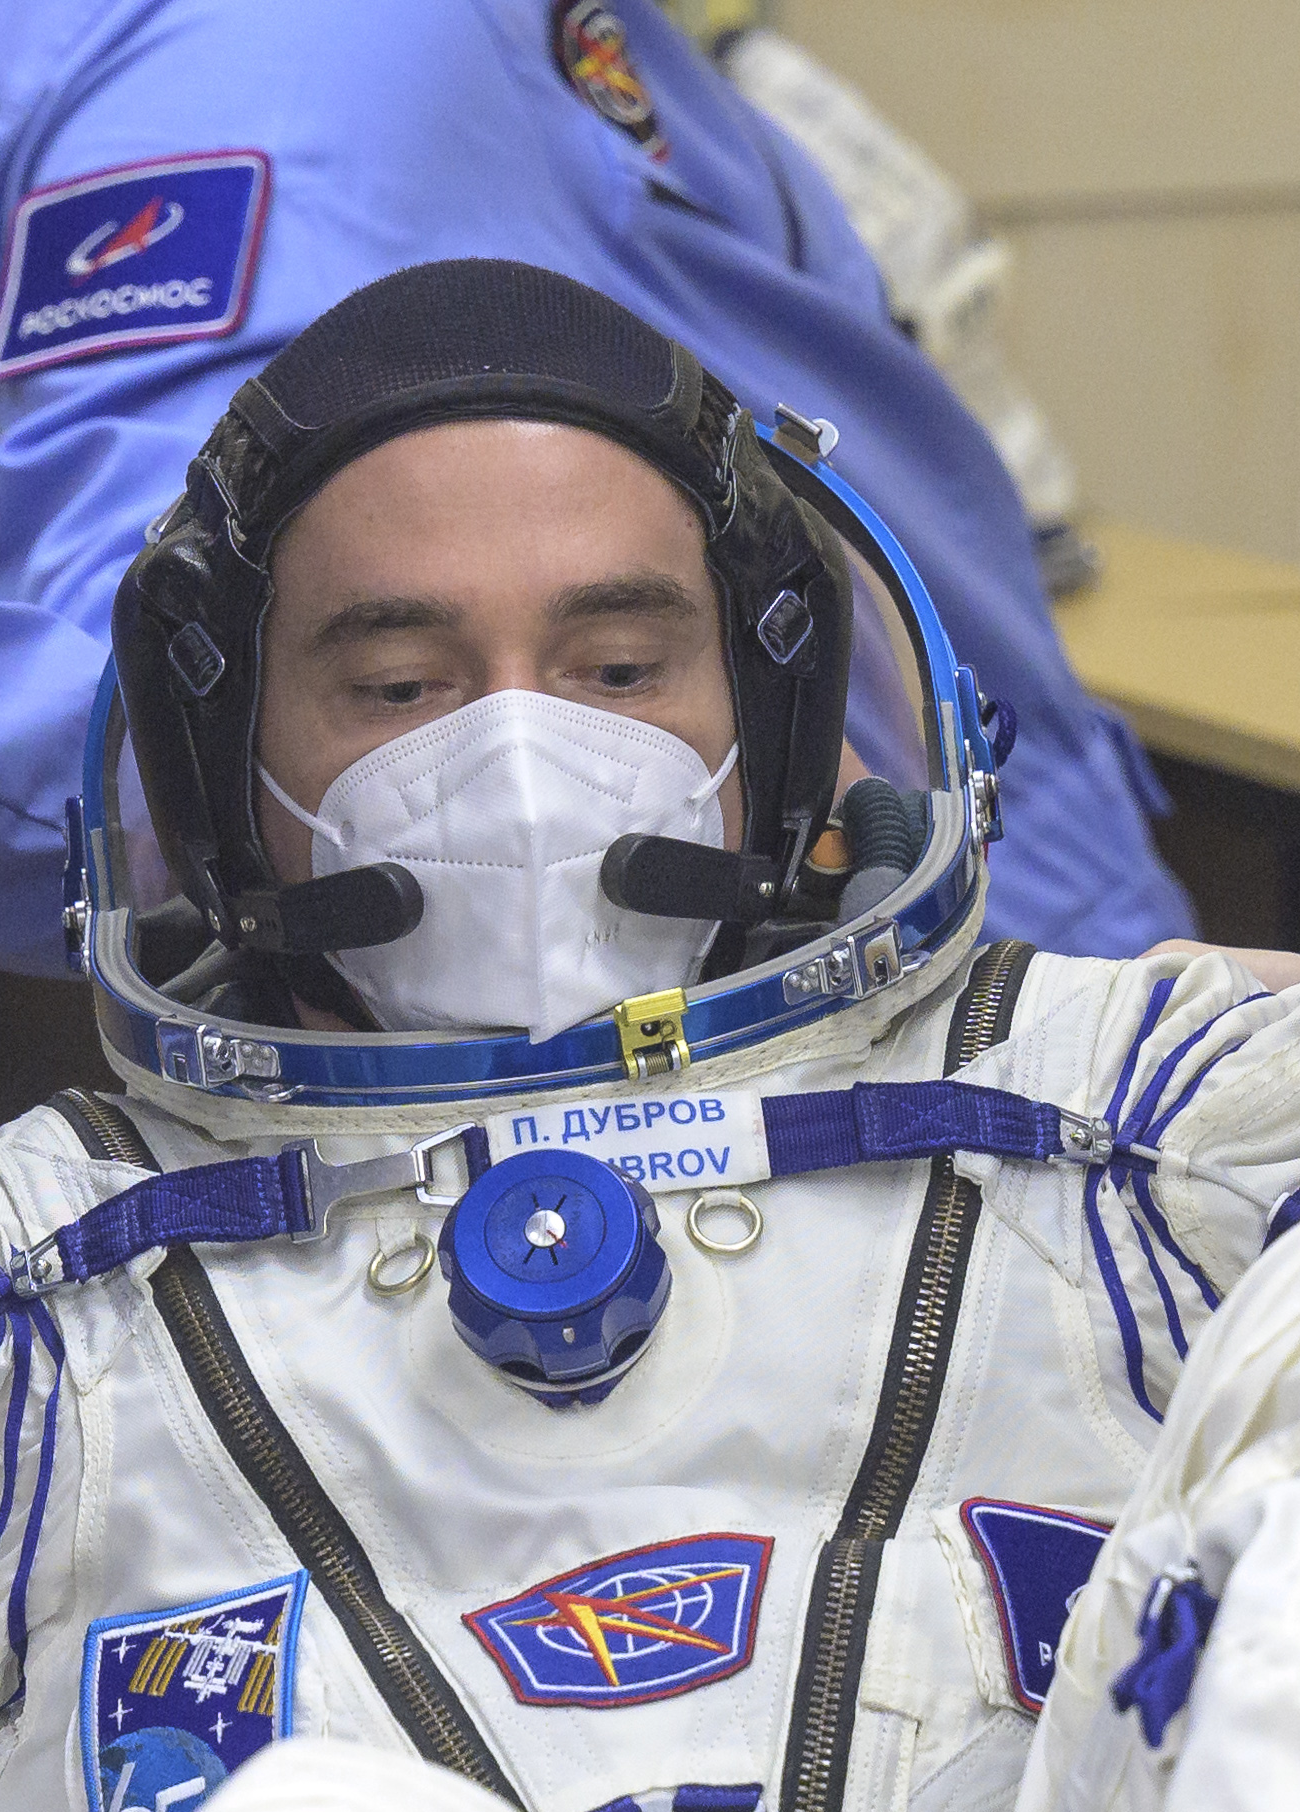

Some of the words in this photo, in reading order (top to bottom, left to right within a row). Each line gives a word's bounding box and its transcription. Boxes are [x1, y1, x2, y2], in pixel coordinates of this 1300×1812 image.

[511, 1115, 550, 1146] П.
[561, 1098, 726, 1144] ДУБРОВ
[607, 1145, 731, 1183] BROV
